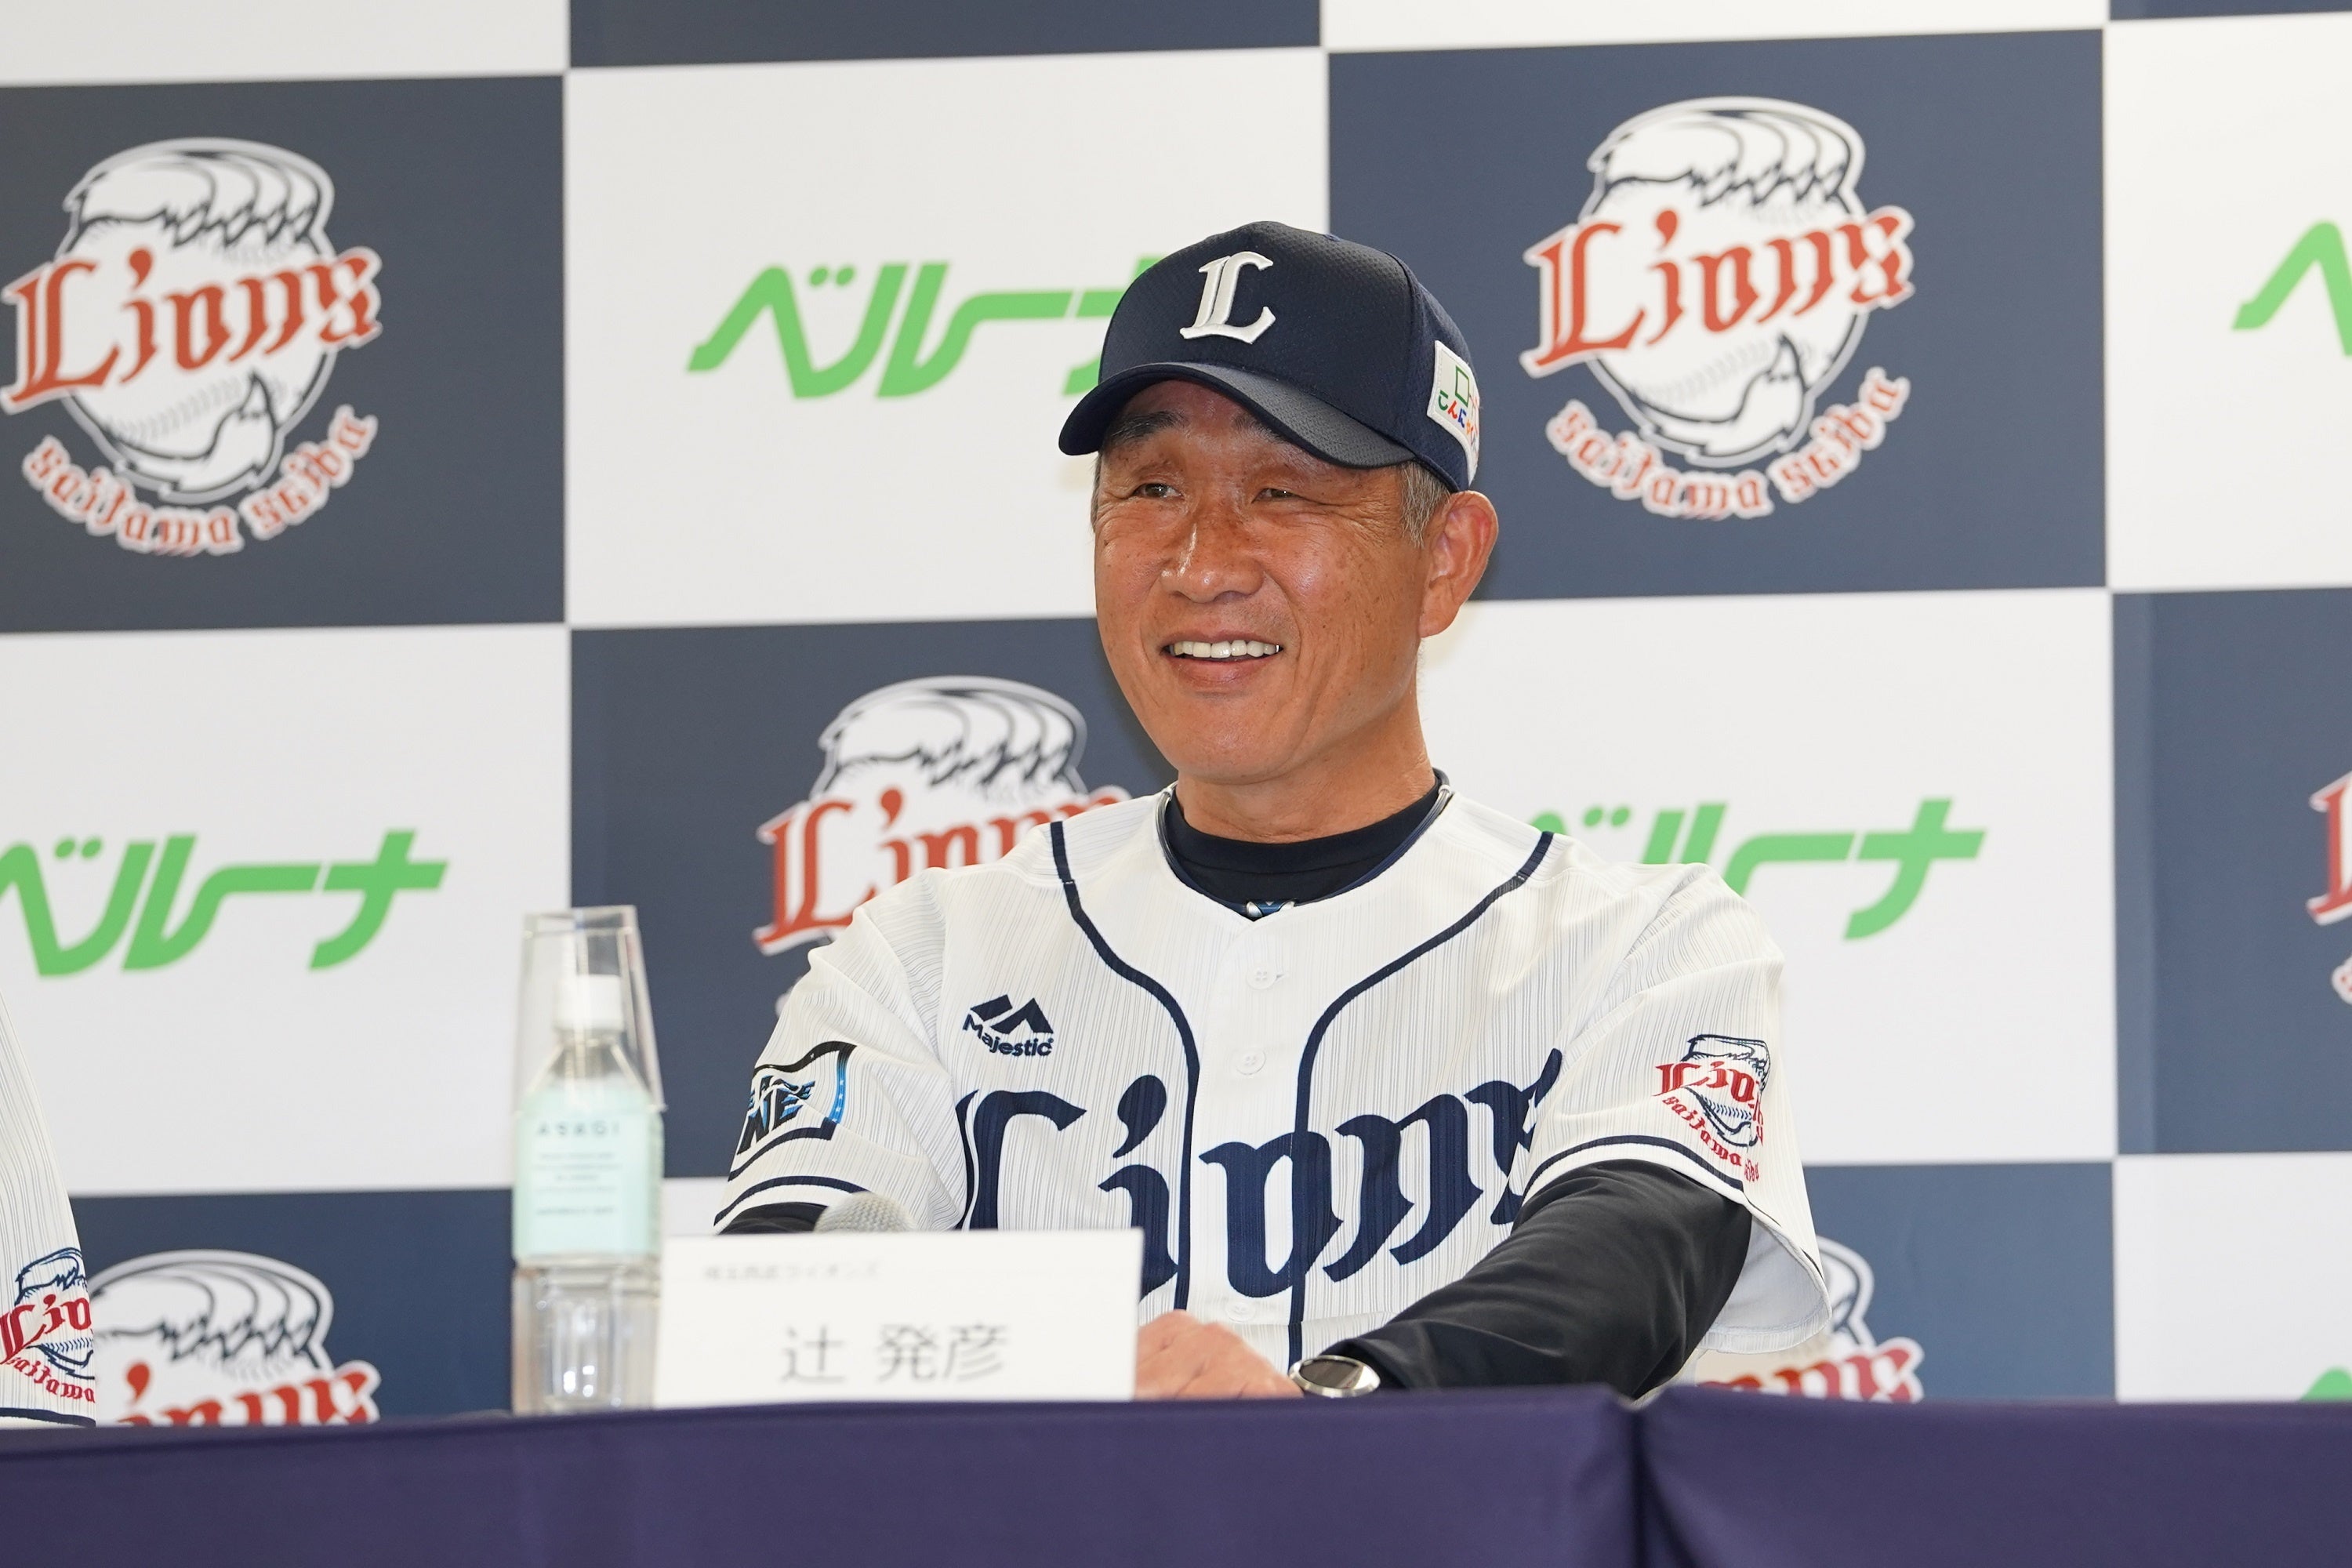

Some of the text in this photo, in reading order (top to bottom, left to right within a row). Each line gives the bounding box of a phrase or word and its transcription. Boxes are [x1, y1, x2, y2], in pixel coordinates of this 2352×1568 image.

[8, 247, 376, 403] Lions
[1180, 251, 1276, 344] L
[1535, 209, 1908, 367] Lions
[963, 1014, 1053, 1056] Majestic
[0, 1294, 92, 1364] Lio
[779, 1321, 1009, 1384] 辻 発彦
